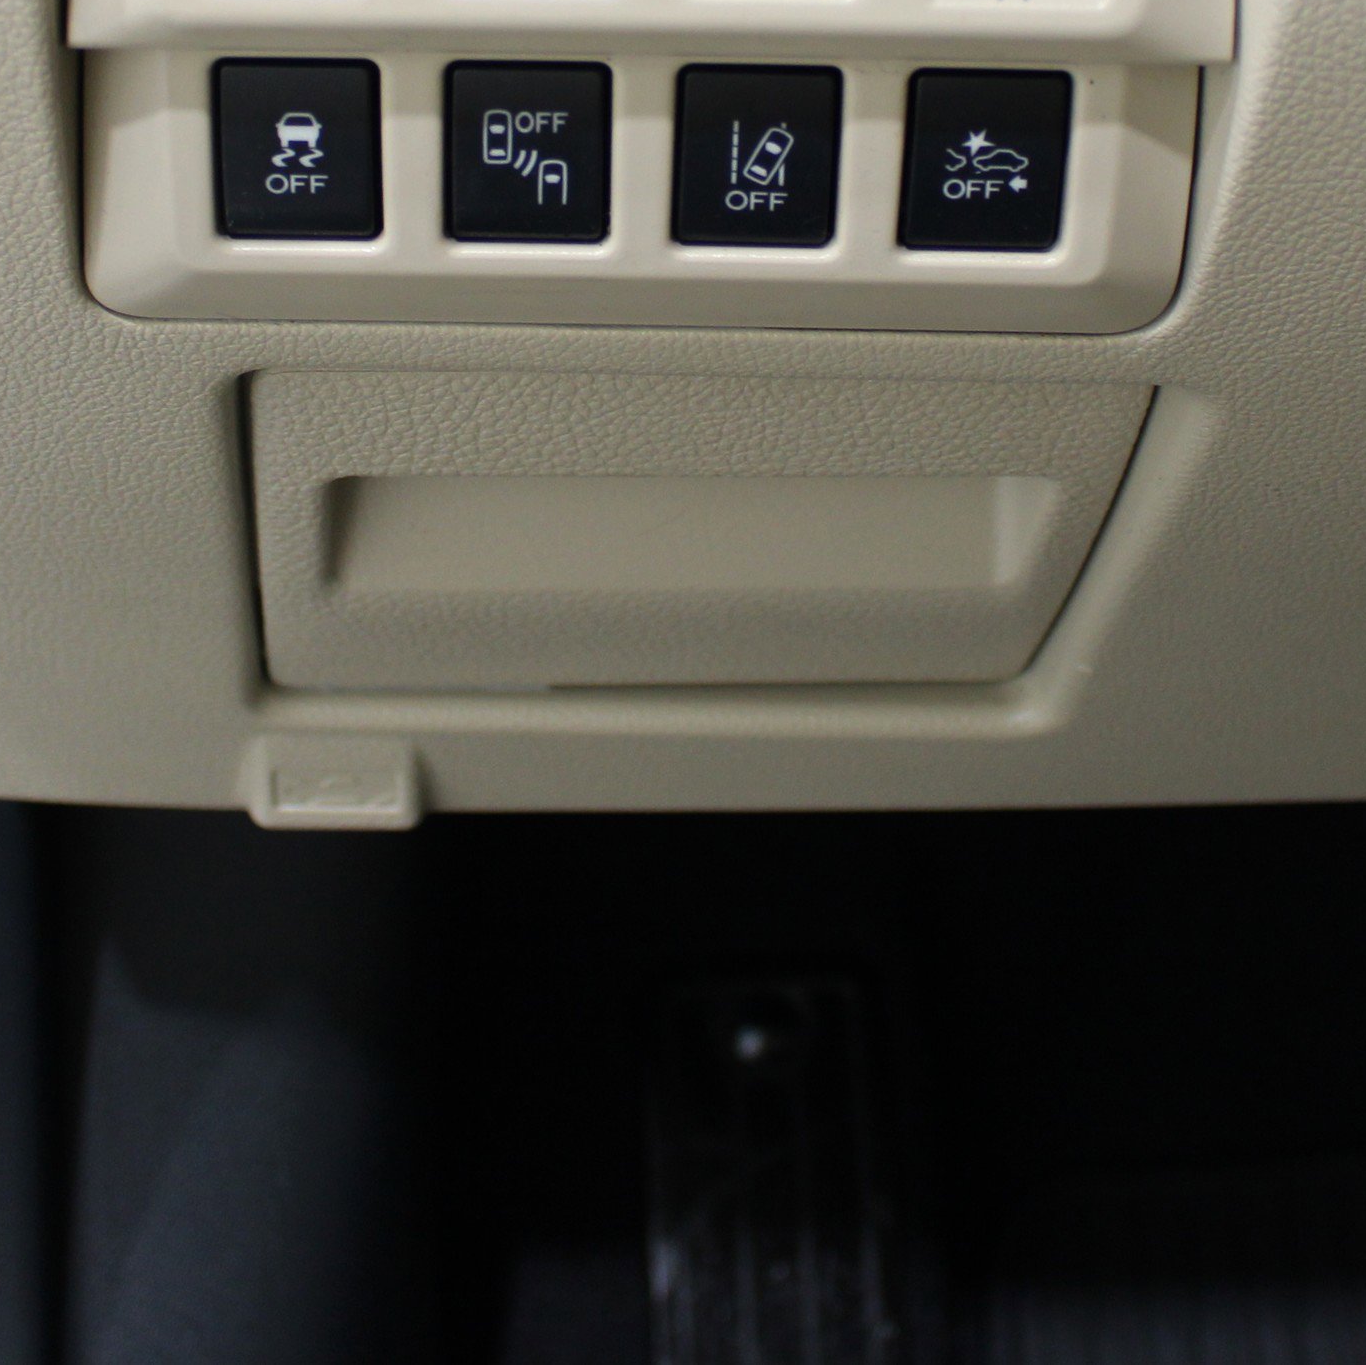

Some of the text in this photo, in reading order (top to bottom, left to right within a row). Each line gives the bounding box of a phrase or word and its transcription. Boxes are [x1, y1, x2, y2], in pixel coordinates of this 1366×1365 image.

[515, 110, 569, 134] OFF
[265, 173, 329, 195] OFF
[942, 178, 1005, 200] OFF
[724, 189, 788, 212] OFF
